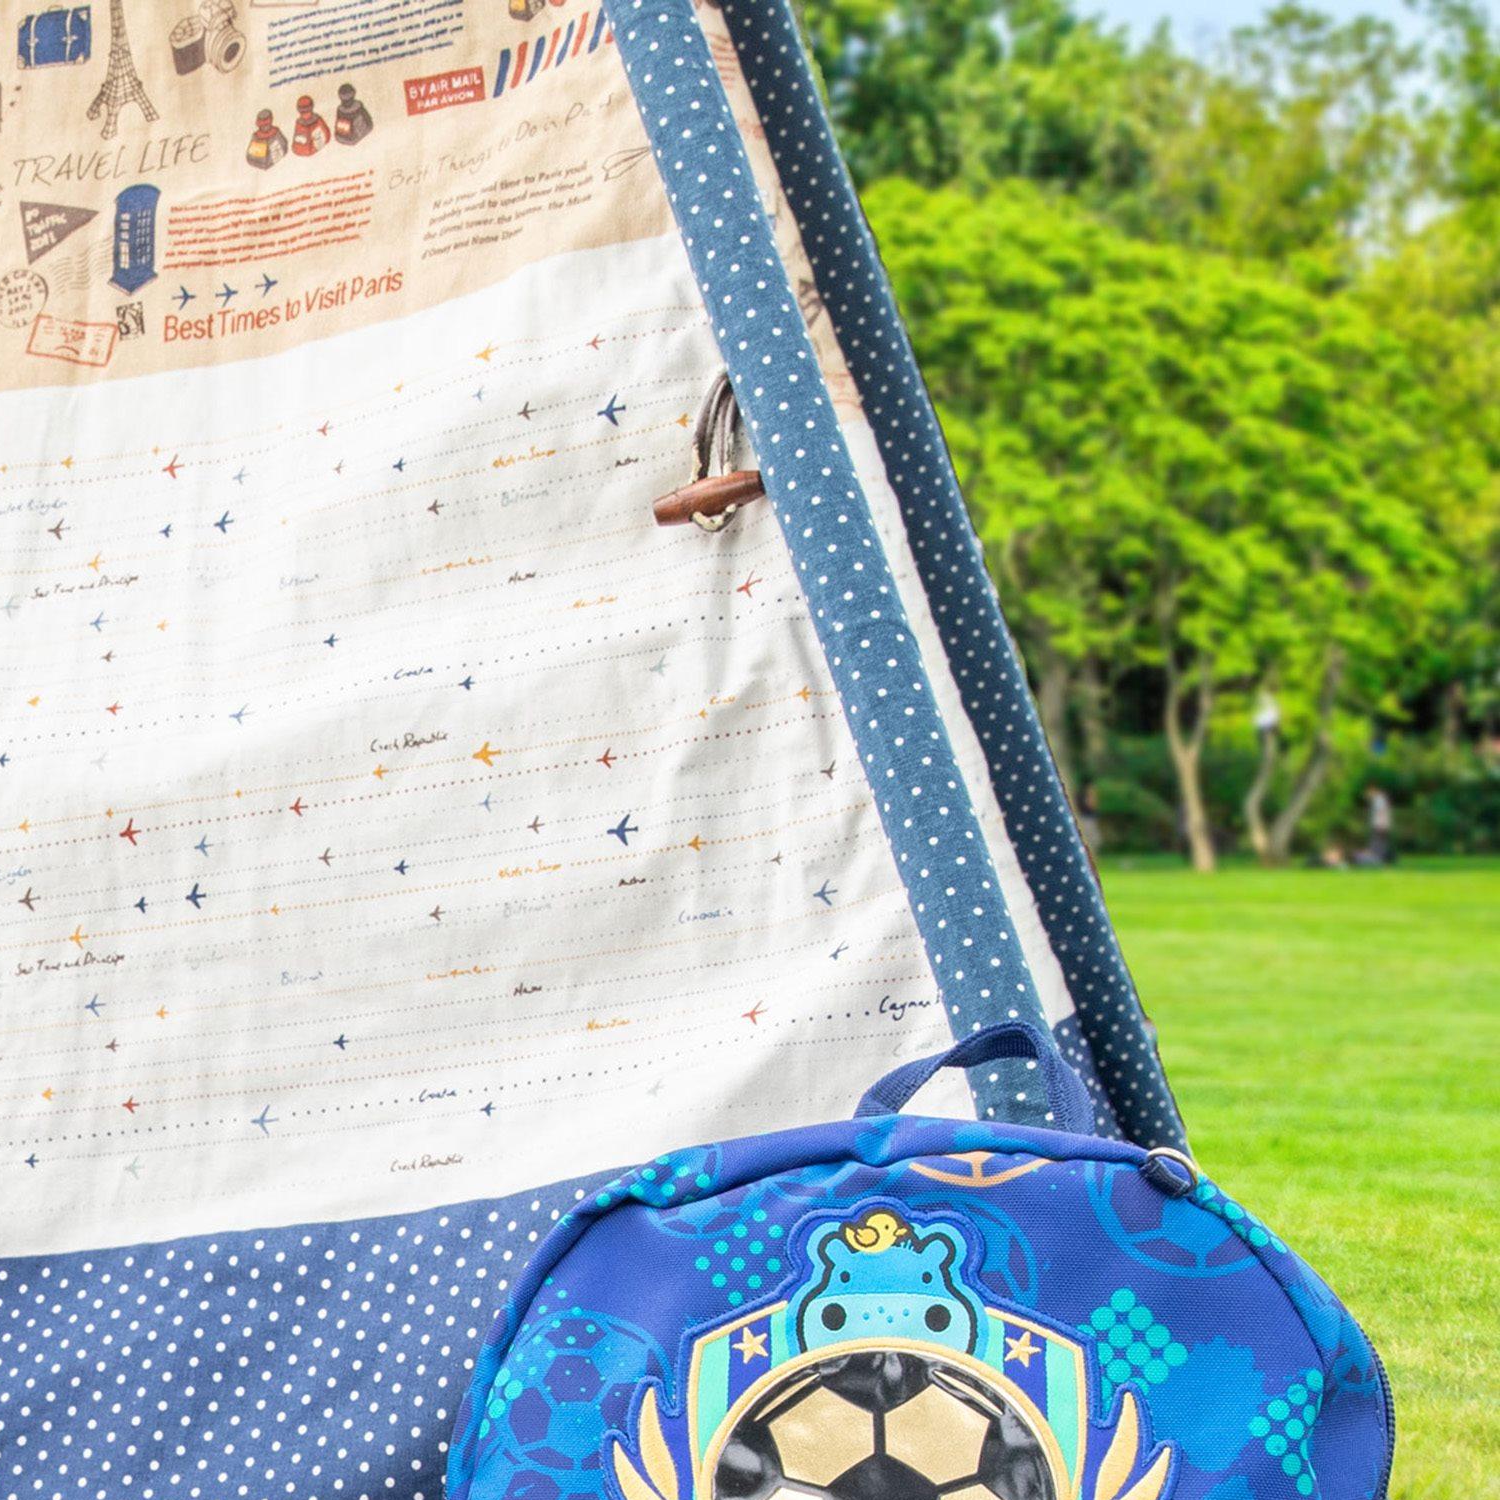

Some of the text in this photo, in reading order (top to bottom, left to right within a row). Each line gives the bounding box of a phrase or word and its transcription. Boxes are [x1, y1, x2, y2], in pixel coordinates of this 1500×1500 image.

[409, 71, 482, 101] BY AIR MAIL
[441, 89, 475, 106] AVION
[13, 132, 210, 186] TRAVEL LIFE
[164, 268, 404, 342] Best Times to Visit Paris
